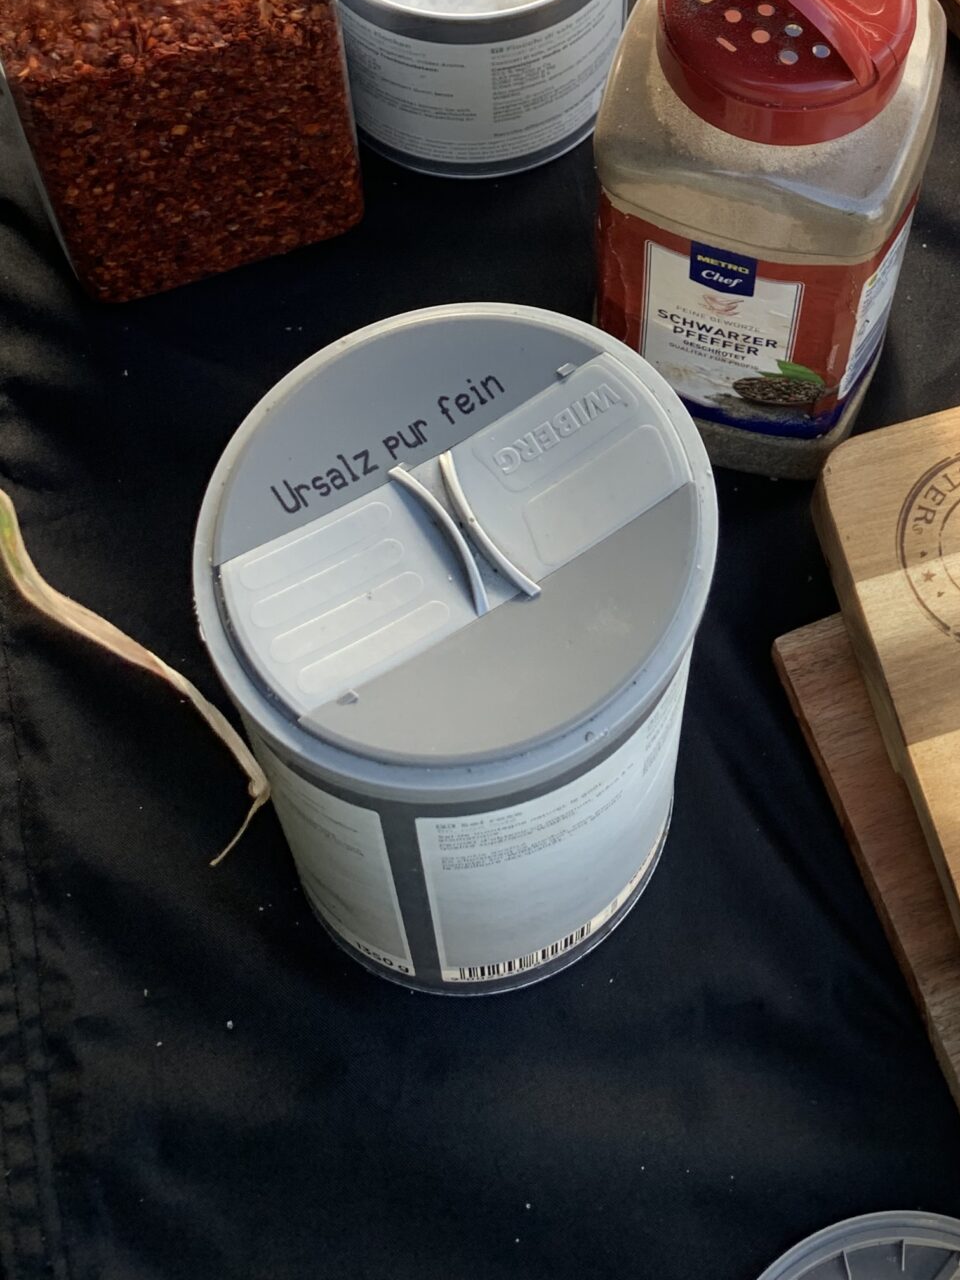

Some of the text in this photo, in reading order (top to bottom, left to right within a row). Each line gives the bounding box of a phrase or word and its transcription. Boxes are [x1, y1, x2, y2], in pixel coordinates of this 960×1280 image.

[697, 254, 750, 274] METRO
[701, 268, 744, 289] Chef
[657, 308, 779, 350] SCHWARZER
[672, 327, 760, 357] PFEFFER
[683, 339, 747, 362] GESCHROTET
[498, 382, 623, 474] WIBERG
[270, 373, 506, 515] Ursalz pur fein
